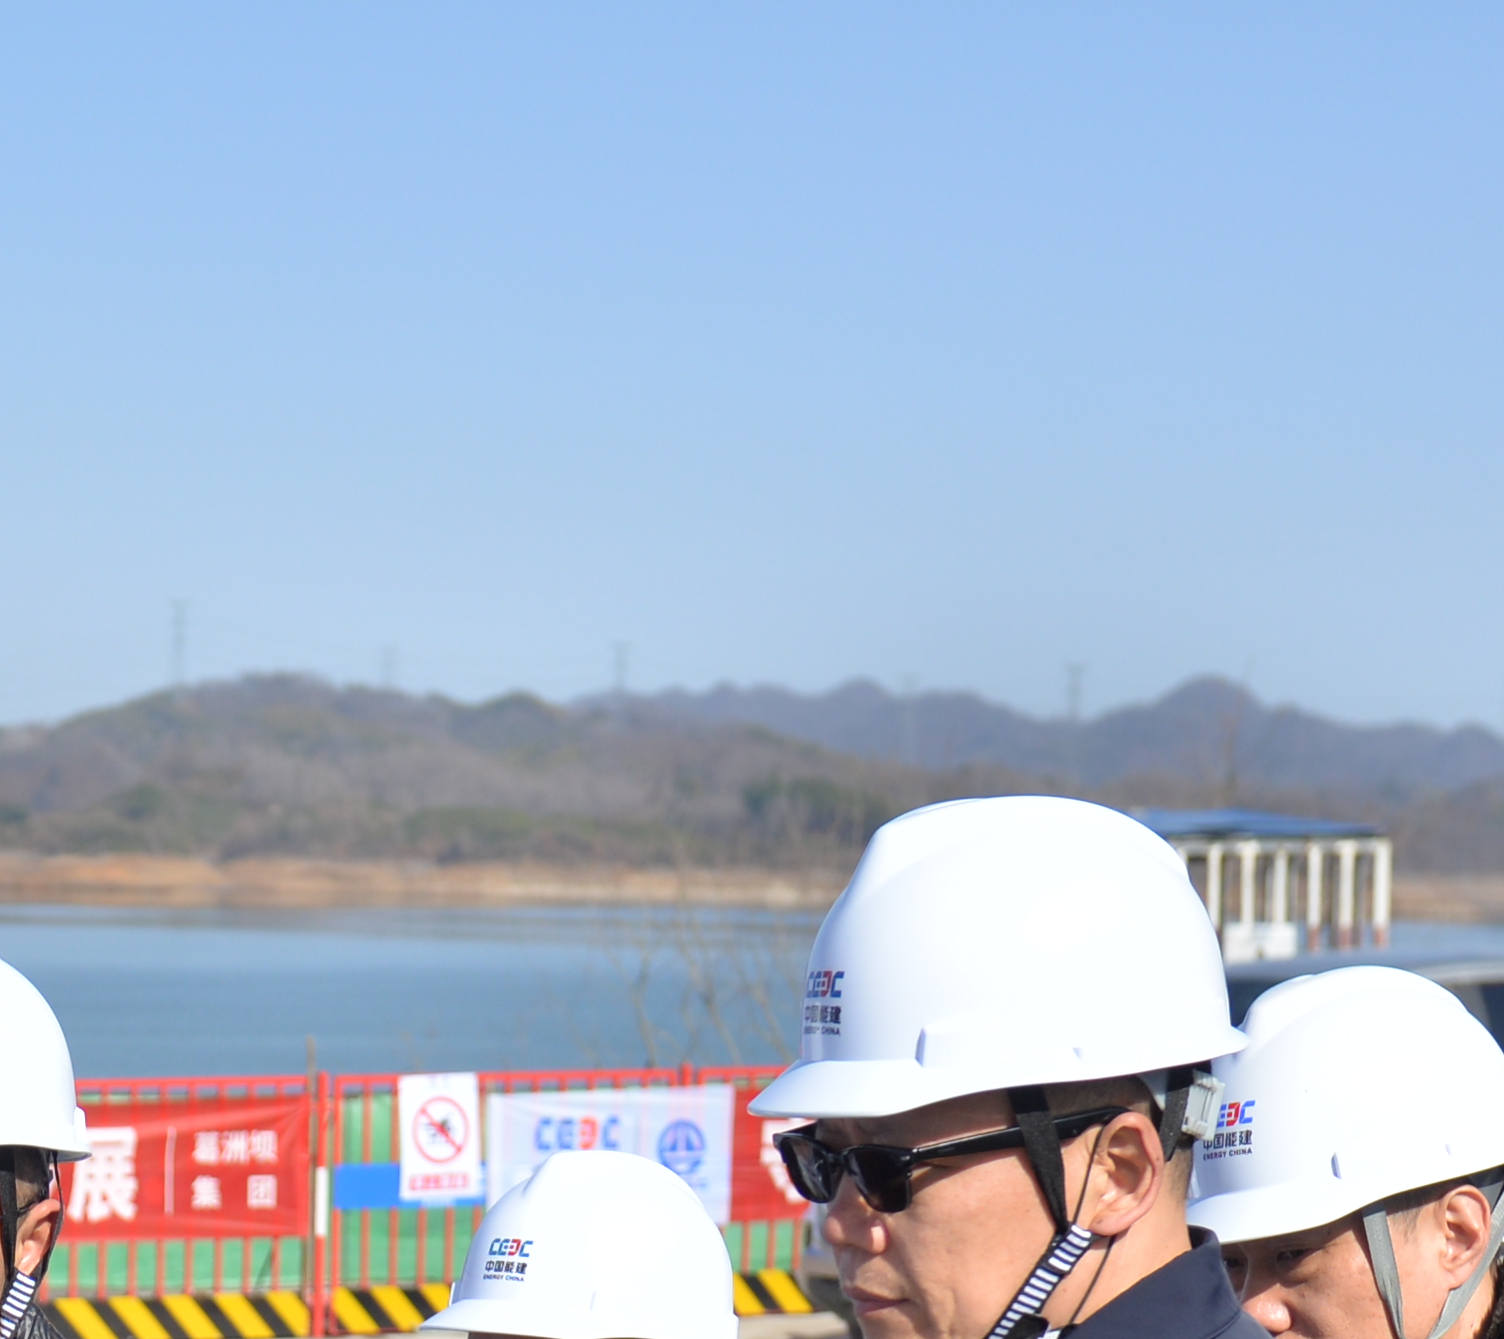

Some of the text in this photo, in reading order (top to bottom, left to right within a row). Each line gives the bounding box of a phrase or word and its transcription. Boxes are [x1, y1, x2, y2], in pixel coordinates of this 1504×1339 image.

[192, 1129, 279, 1166] 葛洲坝
[1203, 1129, 1253, 1152] 中国能建
[66, 1127, 139, 1223] 展
[191, 1173, 279, 1210] 集团
[485, 1259, 528, 1275] 中国能建
